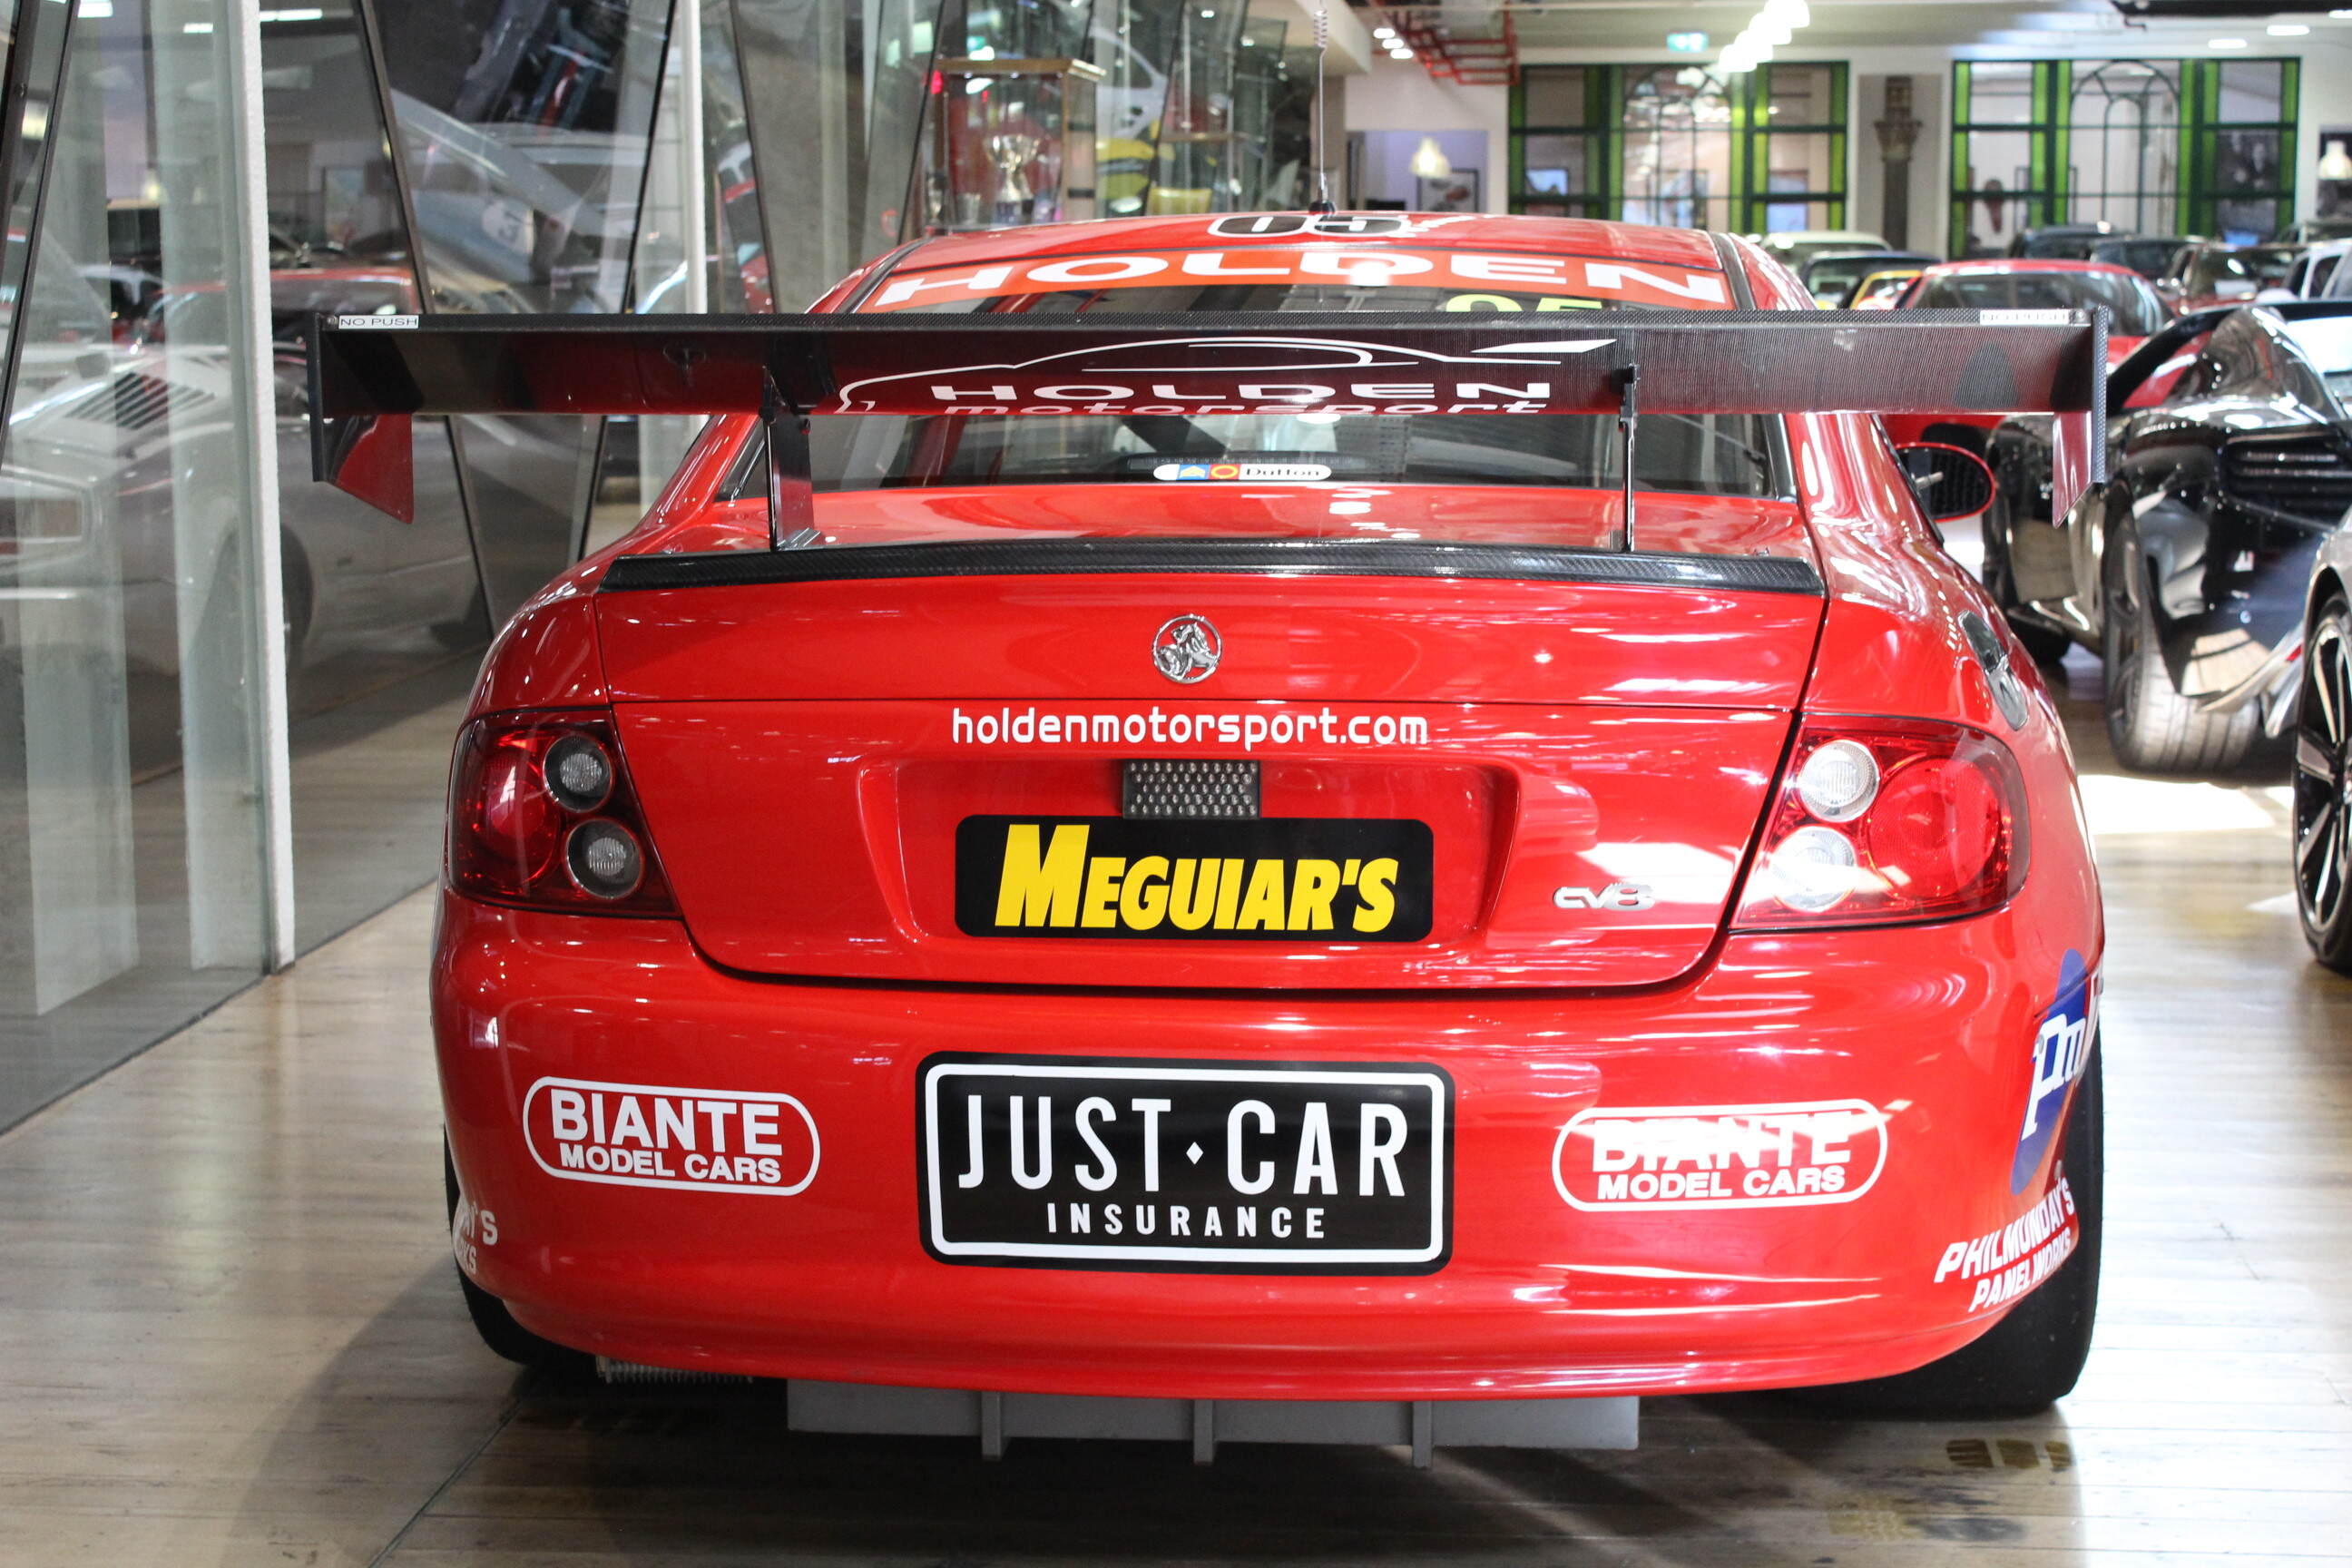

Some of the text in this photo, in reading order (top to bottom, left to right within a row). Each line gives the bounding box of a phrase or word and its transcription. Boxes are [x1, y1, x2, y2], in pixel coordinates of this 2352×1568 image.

[875, 251, 1726, 307] HOLDEN
[340, 318, 417, 327] NO PUSH
[931, 383, 1551, 400] HOLDEN
[944, 401, 1547, 415] motorsport
[1246, 467, 1319, 477] Dutton
[952, 706, 1428, 751] holdenmotorsport.com
[995, 823, 1399, 933] MEGUIAR'S
[1553, 882, 1656, 911] CV8
[550, 1088, 783, 1156] BIANTE
[1592, 1111, 1852, 1172] BIANTE
[559, 1142, 782, 1184] MODEL CARS
[958, 1094, 1408, 1197] JUST CAR
[1597, 1165, 1846, 1200] MODEL CARS
[1047, 1203, 1326, 1239] INSURANCE
[1968, 1226, 2072, 1313] PANEL WORKS
